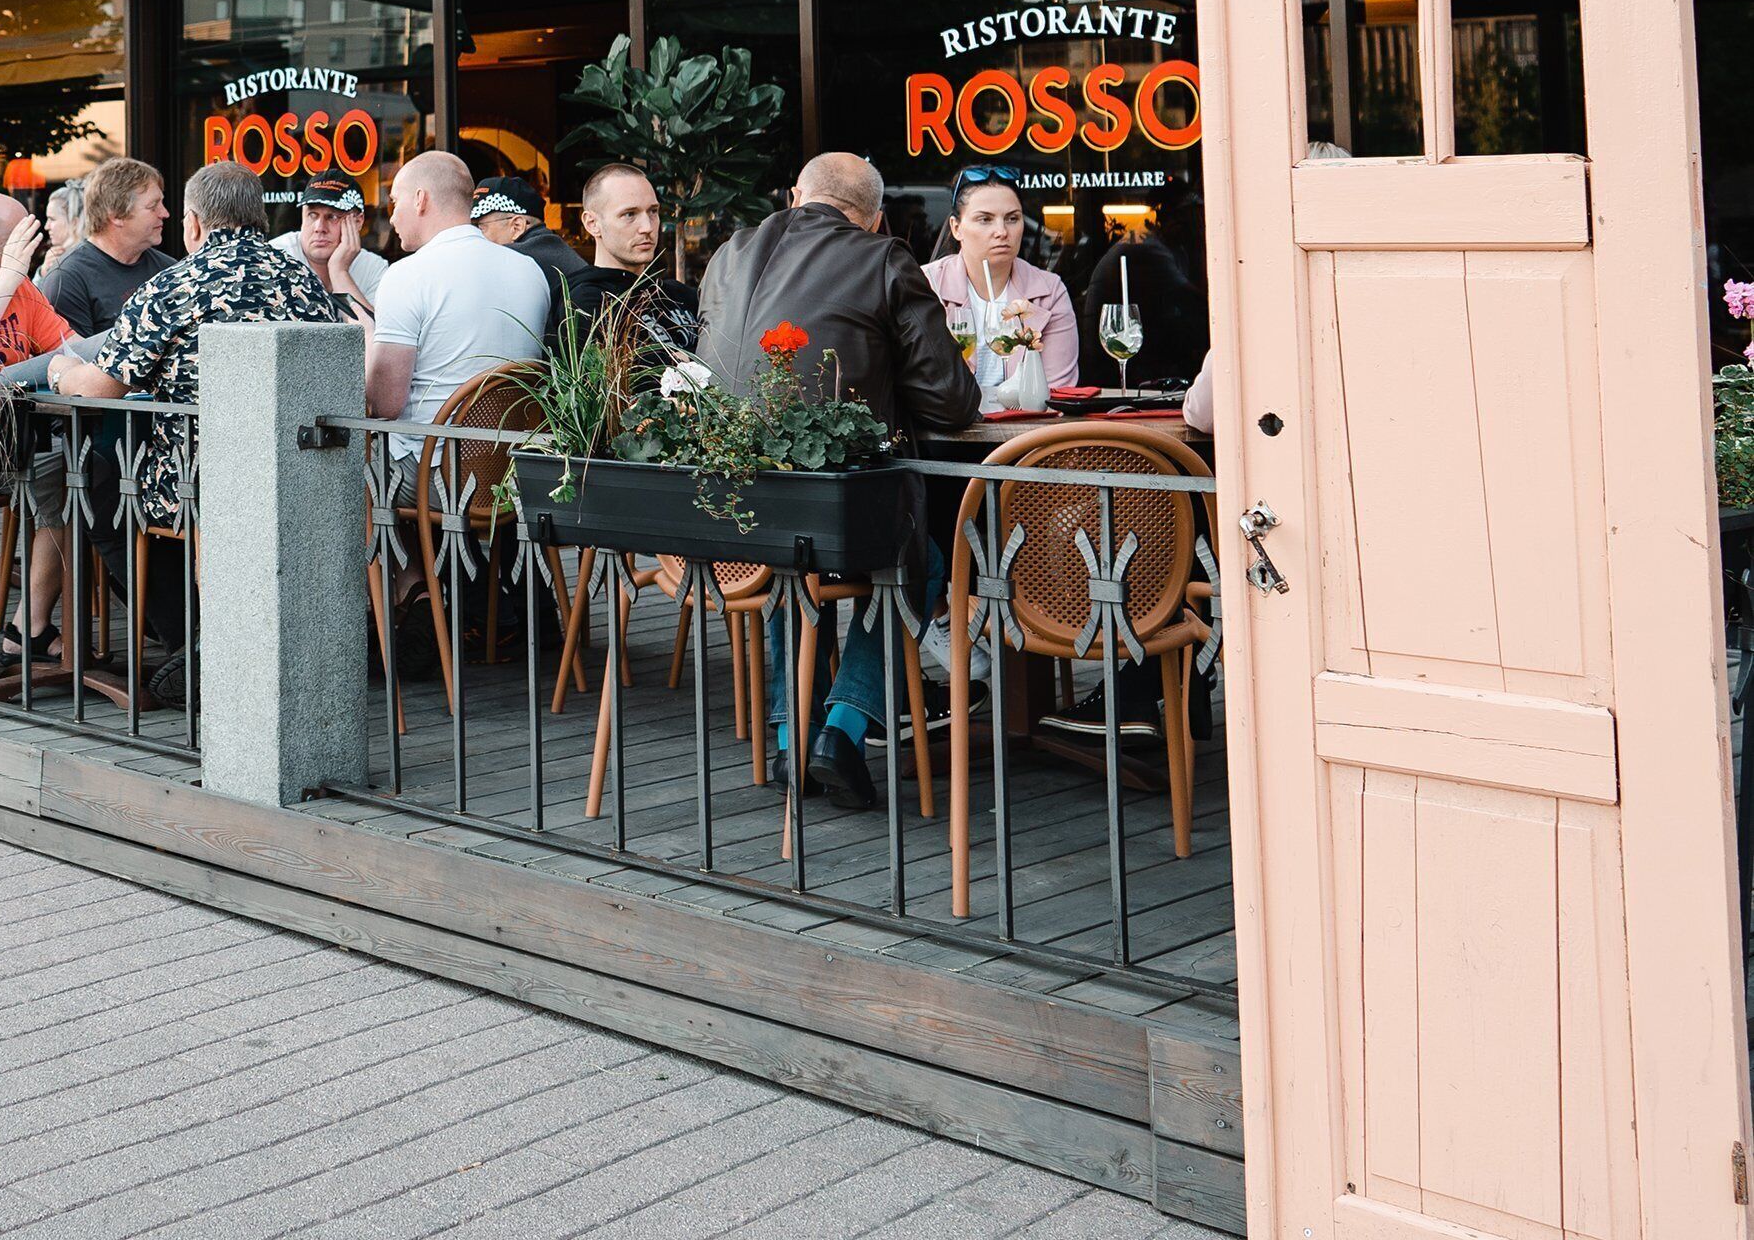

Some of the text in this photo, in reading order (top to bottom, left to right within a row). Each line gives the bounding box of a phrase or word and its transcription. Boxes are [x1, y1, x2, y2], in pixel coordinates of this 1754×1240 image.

[939, 4, 1177, 59] RISTORANTE
[223, 66, 359, 107] RISTORANTE
[905, 59, 1202, 157] ROSSO
[203, 108, 379, 178] ROSSO
[1071, 171, 1166, 189] FAMILIARE
